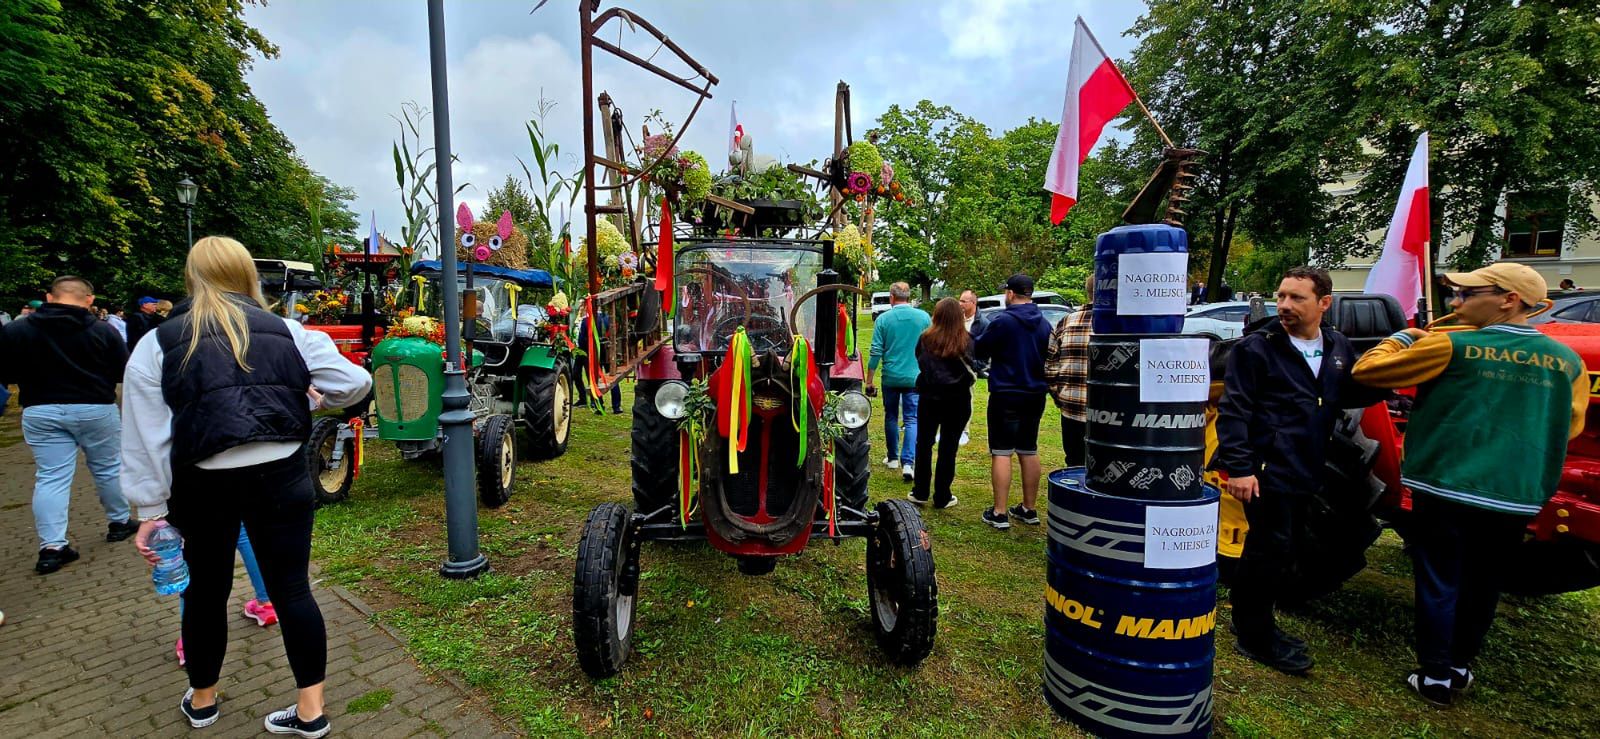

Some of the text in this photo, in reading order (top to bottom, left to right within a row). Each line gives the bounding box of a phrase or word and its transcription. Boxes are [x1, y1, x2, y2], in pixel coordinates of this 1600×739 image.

[1125, 273, 1180, 283] NAGRODA
[1133, 288, 1142, 298] 3.
[1147, 360, 1202, 370] NAGRODA
[1157, 374, 1166, 384] 2.
[1152, 524, 1215, 537] NAGRODA ZA
[1162, 539, 1210, 551] 1. MIEJSCE
